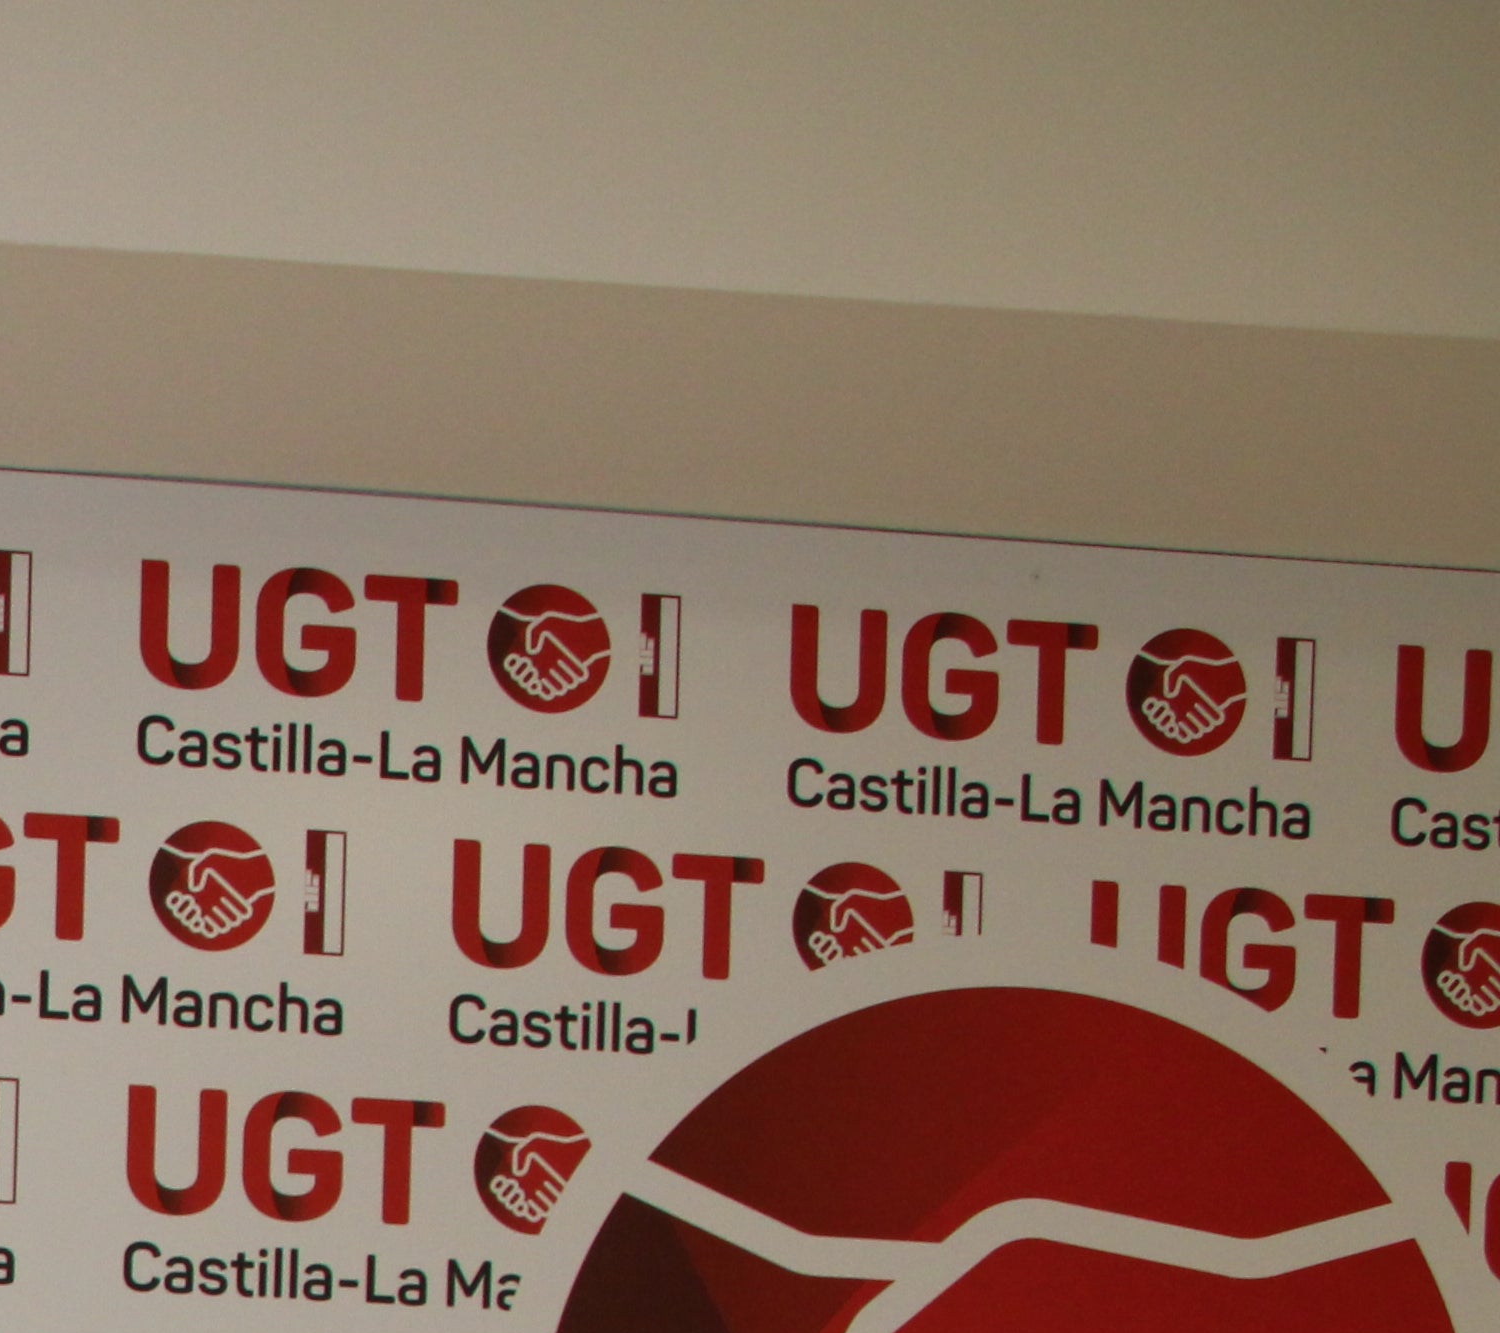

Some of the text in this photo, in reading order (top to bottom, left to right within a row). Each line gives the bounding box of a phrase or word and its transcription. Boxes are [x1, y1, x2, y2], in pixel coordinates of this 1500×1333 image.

[140, 559, 459, 702] UGT
[790, 604, 1099, 745] UGT
[137, 715, 677, 798] Castilla-La Mancha
[787, 758, 1310, 840] Castilla-La Mancha
[452, 839, 765, 980] UGT
[121, 975, 342, 1036] Mancha
[126, 1085, 445, 1225] UGT
[123, 1241, 427, 1306] Castilla-La
